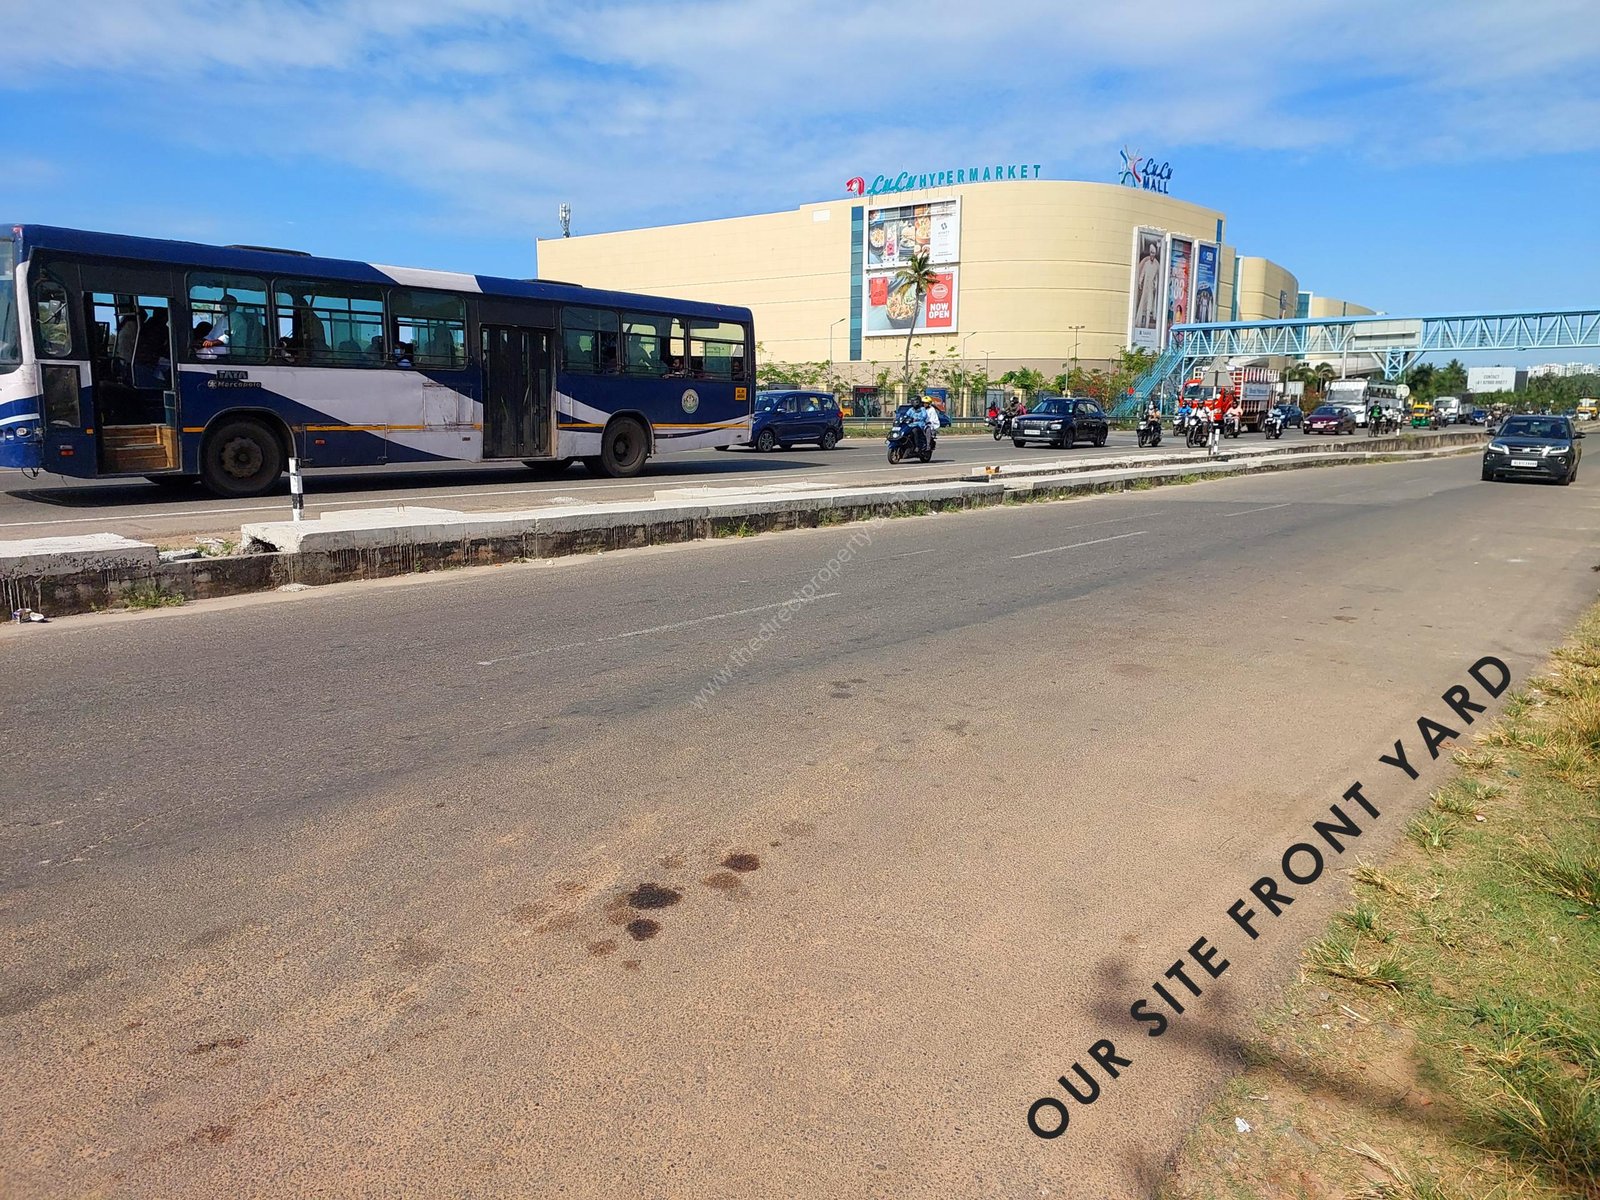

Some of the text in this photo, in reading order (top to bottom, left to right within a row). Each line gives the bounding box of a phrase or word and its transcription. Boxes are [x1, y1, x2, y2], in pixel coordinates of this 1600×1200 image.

[867, 164, 1041, 195] LuLu HYPERMARKET
[1142, 175, 1169, 194] MALL
[929, 303, 949, 311] NOW
[928, 310, 950, 319] OPEN
[216, 370, 247, 379] TATA
